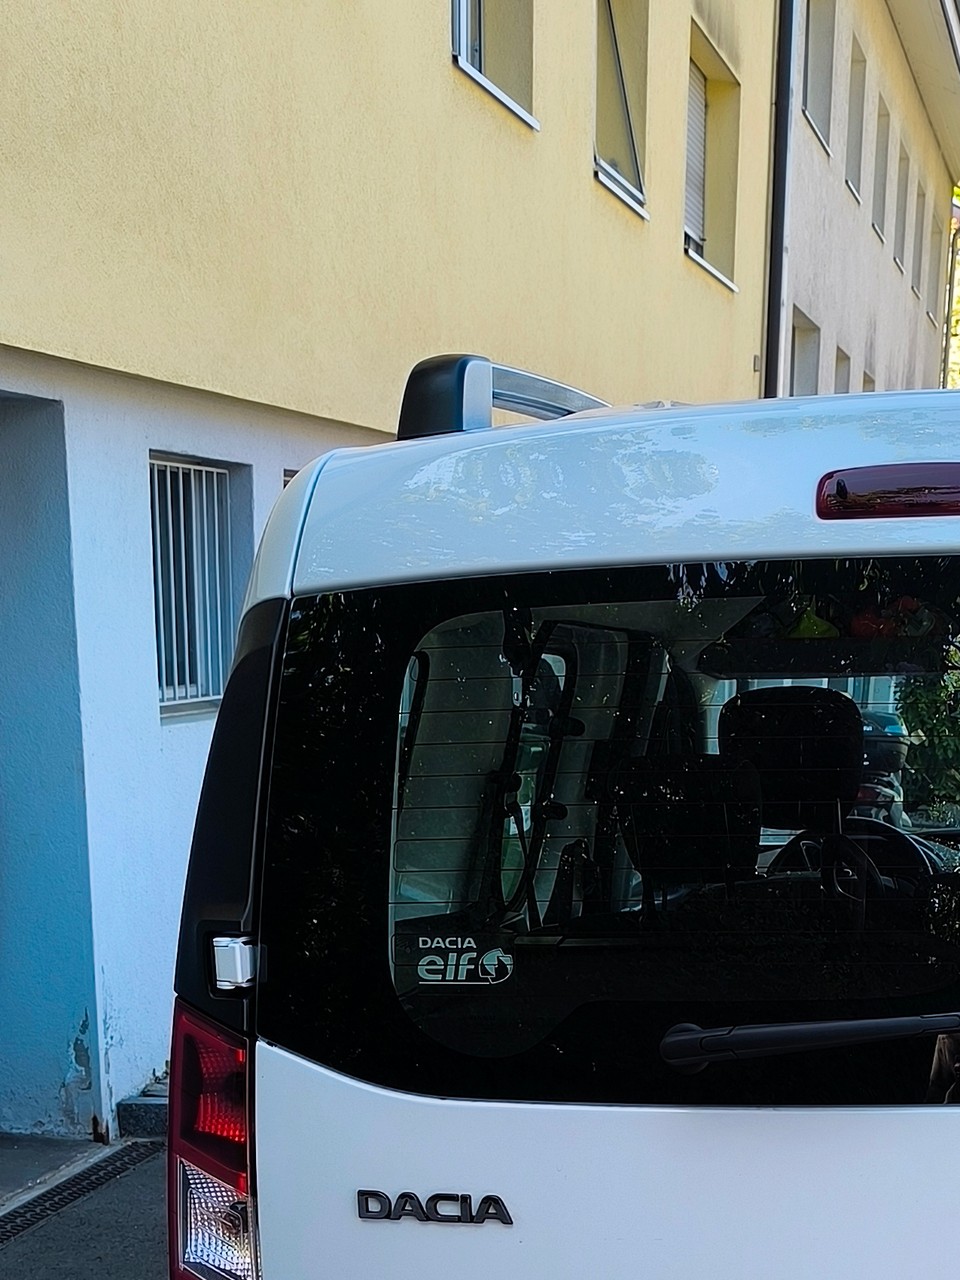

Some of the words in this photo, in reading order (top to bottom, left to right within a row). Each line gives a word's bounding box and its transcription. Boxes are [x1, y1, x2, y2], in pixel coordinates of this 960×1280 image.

[418, 937, 477, 949] DACIA
[417, 952, 478, 980] elf
[356, 1189, 514, 1225] DACIA
